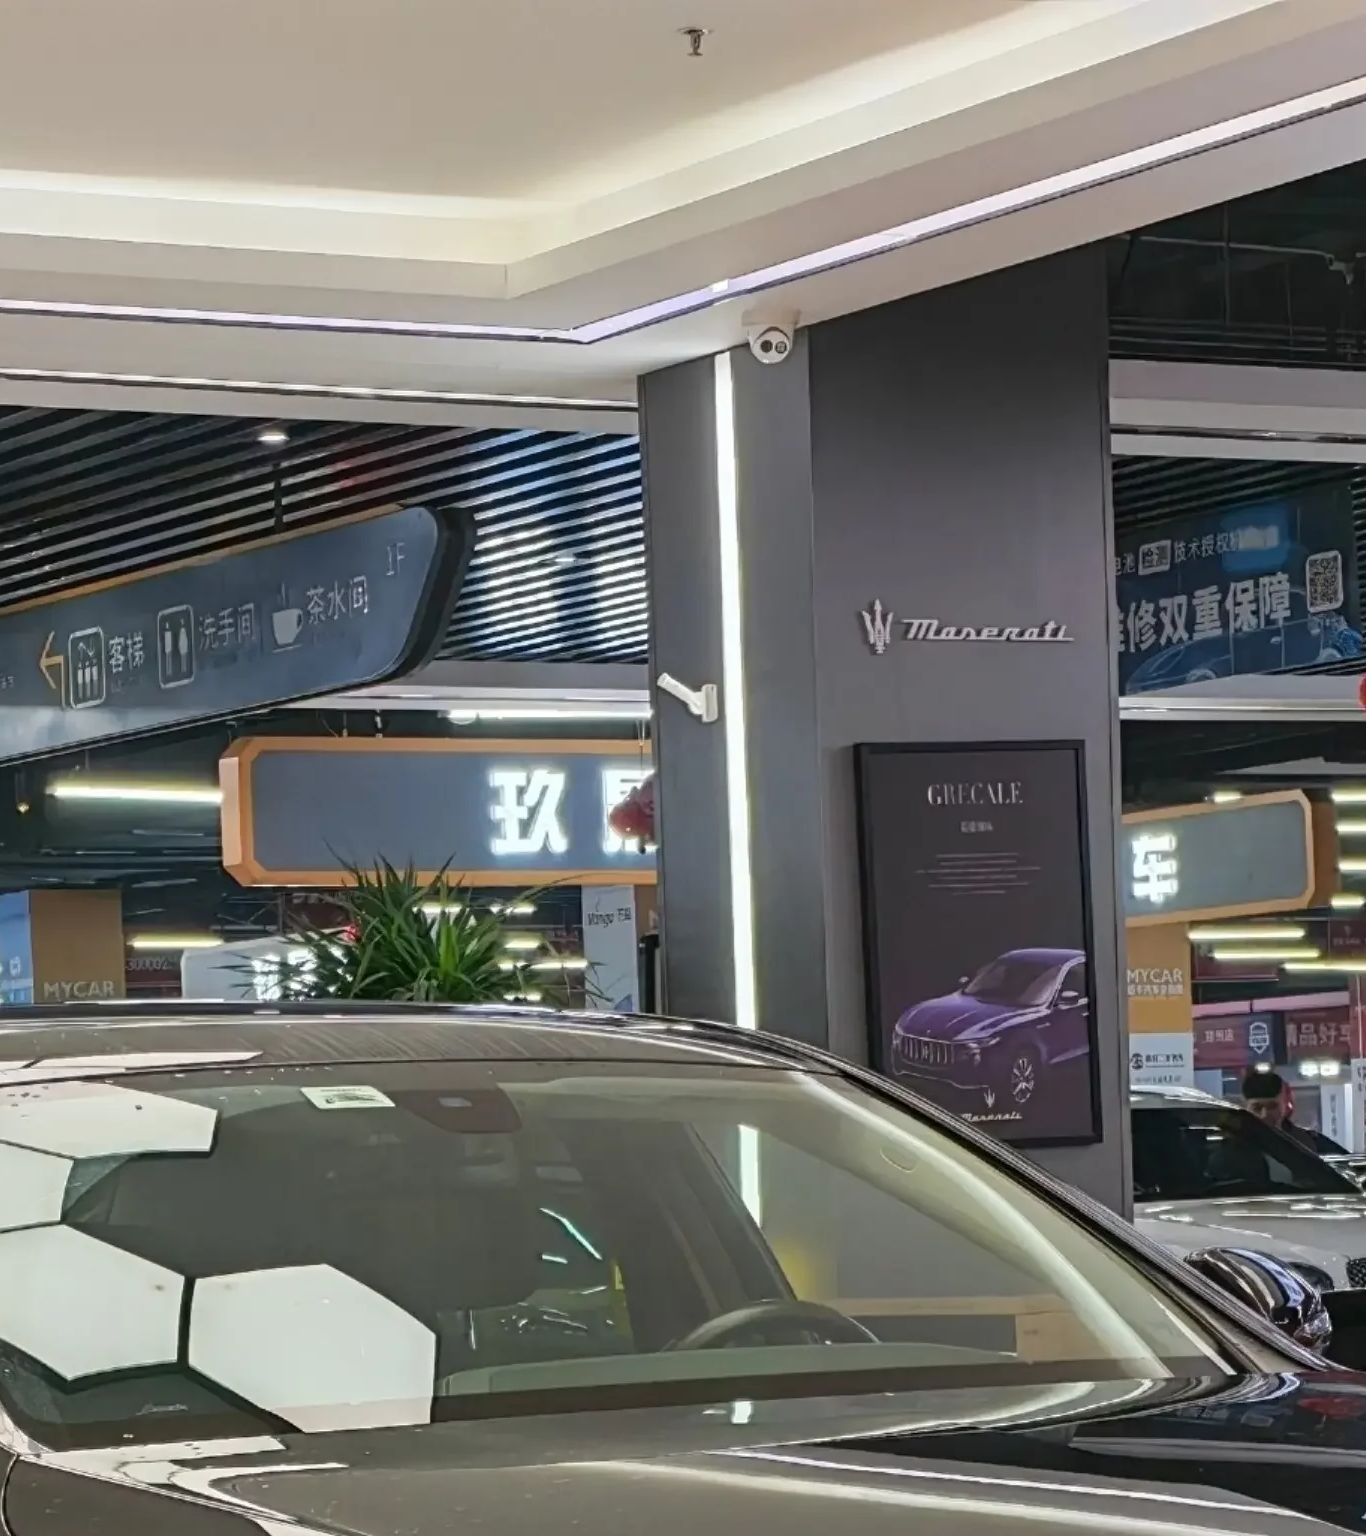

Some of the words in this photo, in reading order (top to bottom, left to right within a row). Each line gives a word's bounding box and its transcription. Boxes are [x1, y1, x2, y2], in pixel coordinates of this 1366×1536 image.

[109, 632, 145, 673] 客梯
[198, 602, 256, 650] 洗手间
[306, 575, 369, 626] 茶水间
[901, 619, 1075, 641] Maserati
[927, 781, 1024, 806] GRECALE
[43, 981, 115, 999] MYCAR
